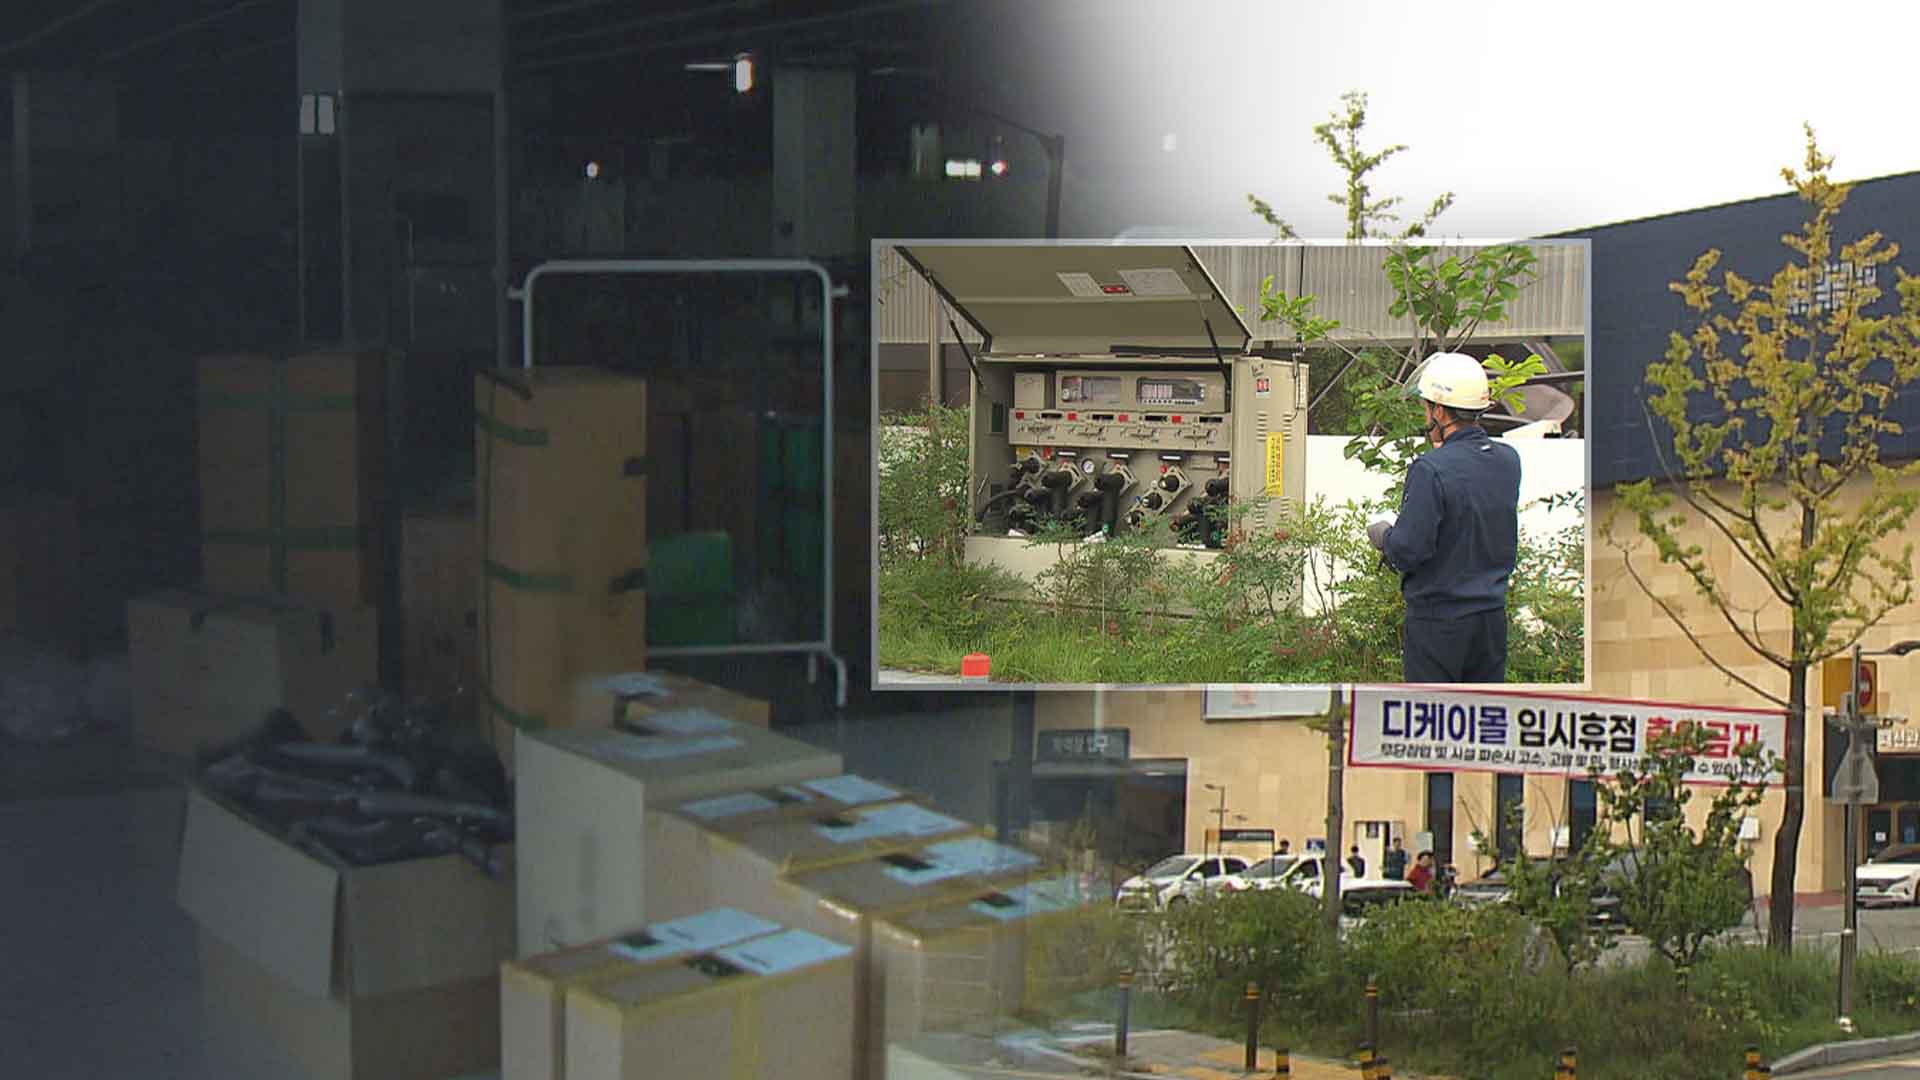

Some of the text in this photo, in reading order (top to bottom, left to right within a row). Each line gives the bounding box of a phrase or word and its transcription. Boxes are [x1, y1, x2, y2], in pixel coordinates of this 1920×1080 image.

[1382, 700, 1508, 744] 디케이몰
[1518, 708, 1637, 753] 임시휴점
[1450, 747, 1475, 762] 시설
